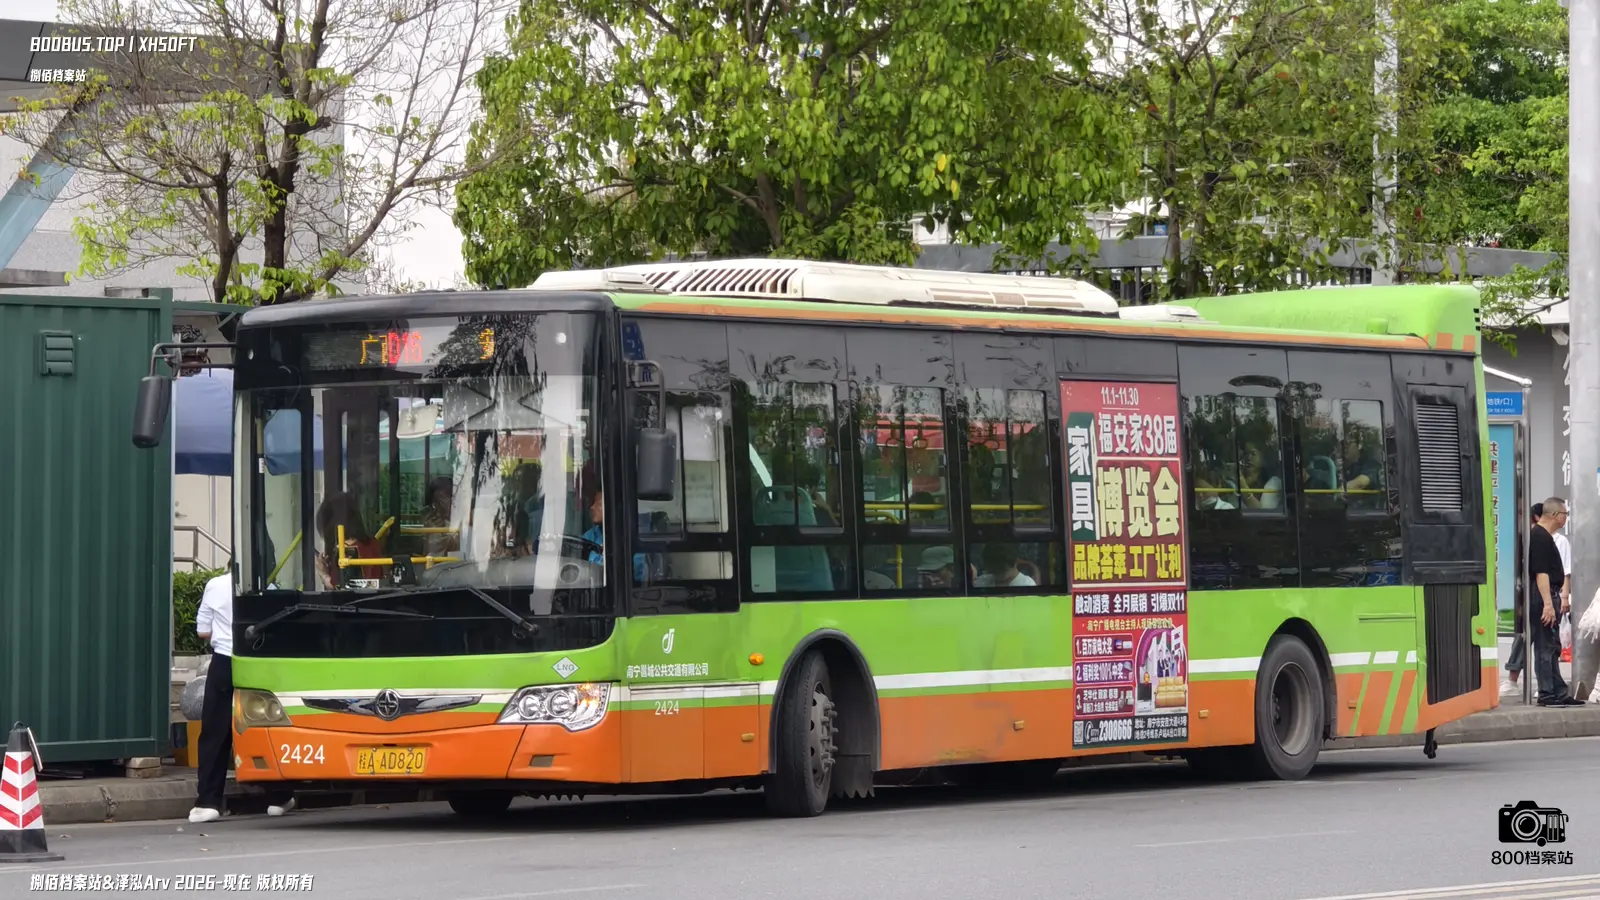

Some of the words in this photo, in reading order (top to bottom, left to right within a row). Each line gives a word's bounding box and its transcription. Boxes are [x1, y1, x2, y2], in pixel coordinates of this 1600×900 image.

[1100, 386, 1140, 406] 11.1-11.30
[1098, 412, 1178, 456] 福安家38届
[1067, 425, 1094, 532] 家具
[1097, 466, 1180, 539] 博览会
[1073, 544, 1127, 581] 品牌荟萃
[1129, 543, 1182, 579] 工厂让利
[1151, 592, 1185, 613] 引爆双11
[556, 663, 576, 672] LNG
[654, 700, 680, 716] 2424
[1098, 718, 1133, 742] 2308666
[280, 743, 326, 765] 2424
[380, 751, 424, 770] AD820
